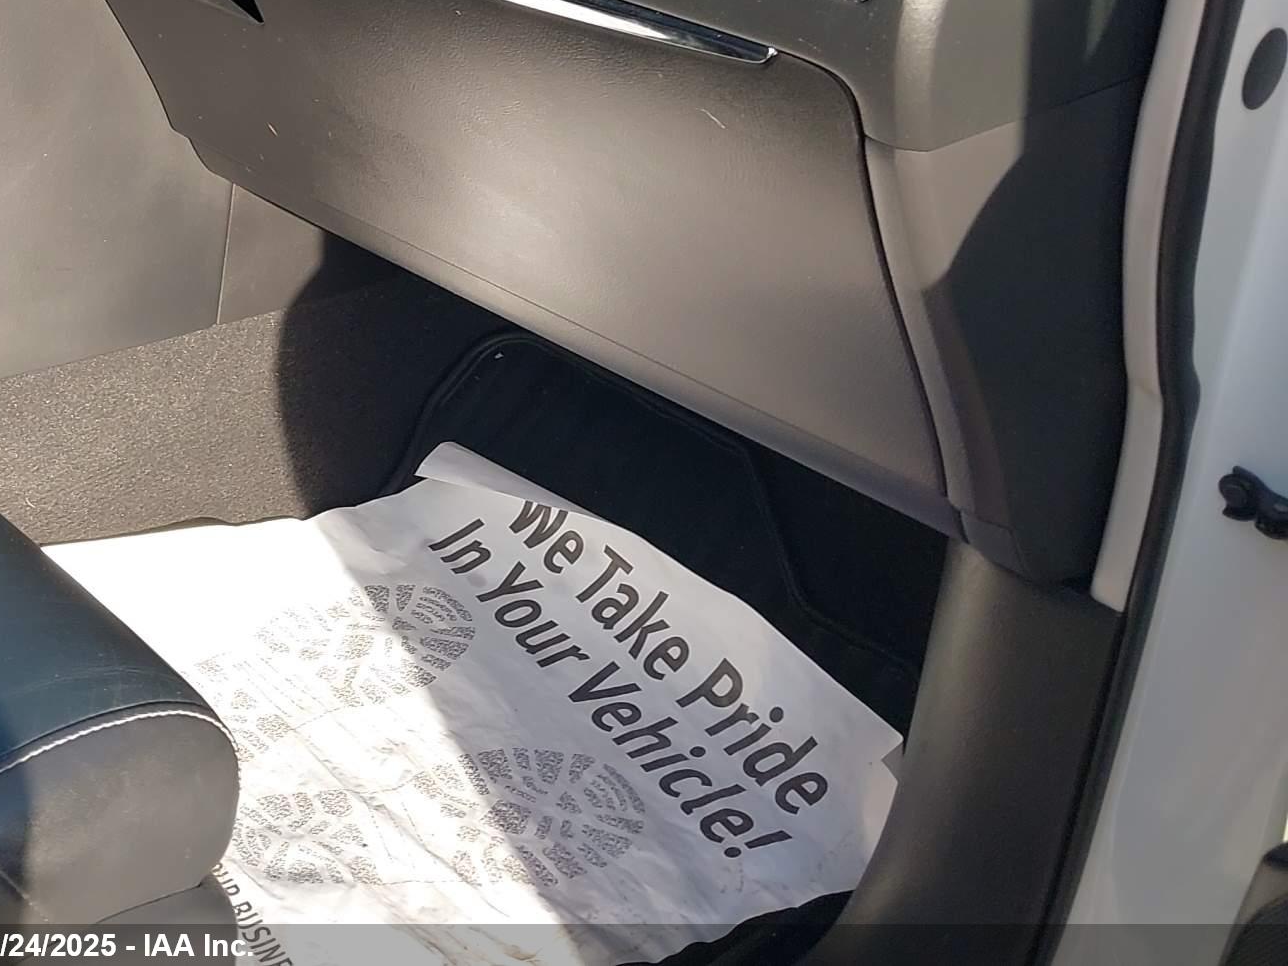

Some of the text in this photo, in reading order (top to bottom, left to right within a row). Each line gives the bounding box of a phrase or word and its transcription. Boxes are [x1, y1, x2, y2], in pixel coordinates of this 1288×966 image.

[428, 518, 793, 858] In Your Vehicle!
[508, 500, 829, 814] We Take Pride
